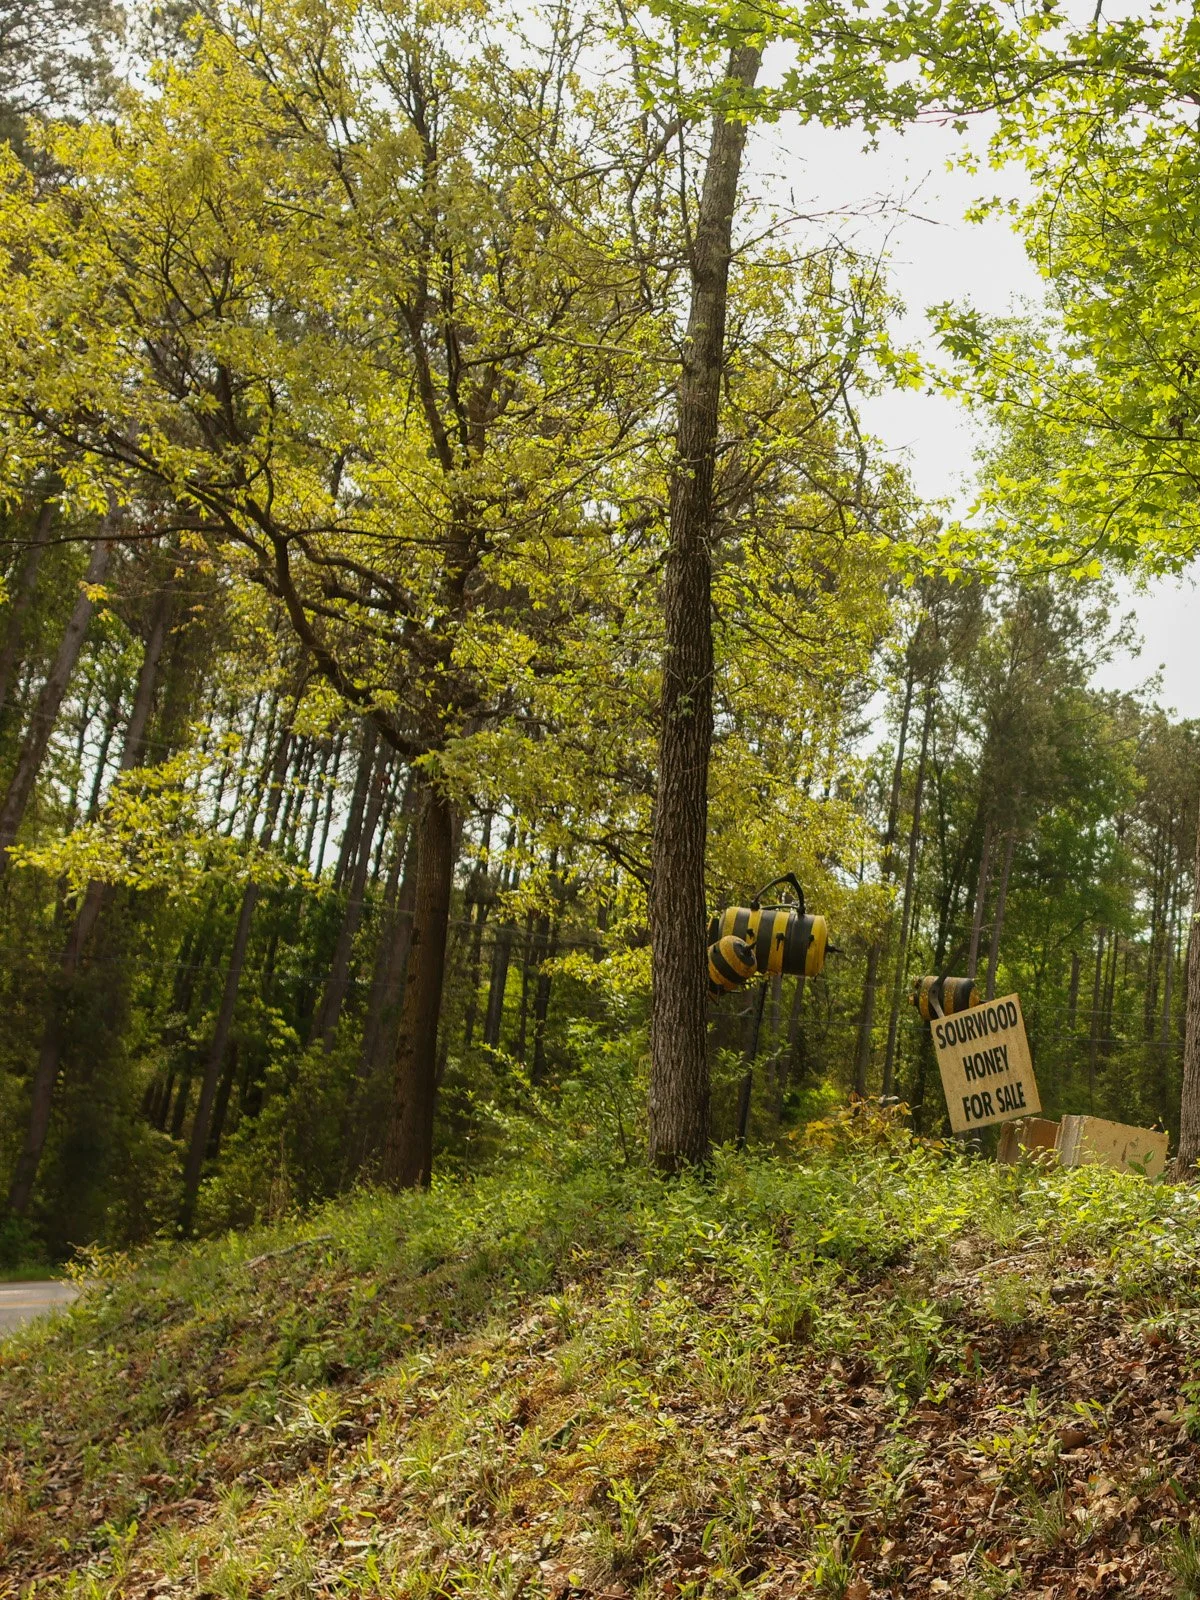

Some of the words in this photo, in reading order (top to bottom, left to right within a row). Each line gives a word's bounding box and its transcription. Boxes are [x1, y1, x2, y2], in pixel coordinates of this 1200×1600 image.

[935, 1001, 1017, 1049] SOURWOOD
[962, 1045, 1009, 1081] HONEY
[962, 1091, 995, 1122] FOR
[995, 1081, 1026, 1113] SALE
